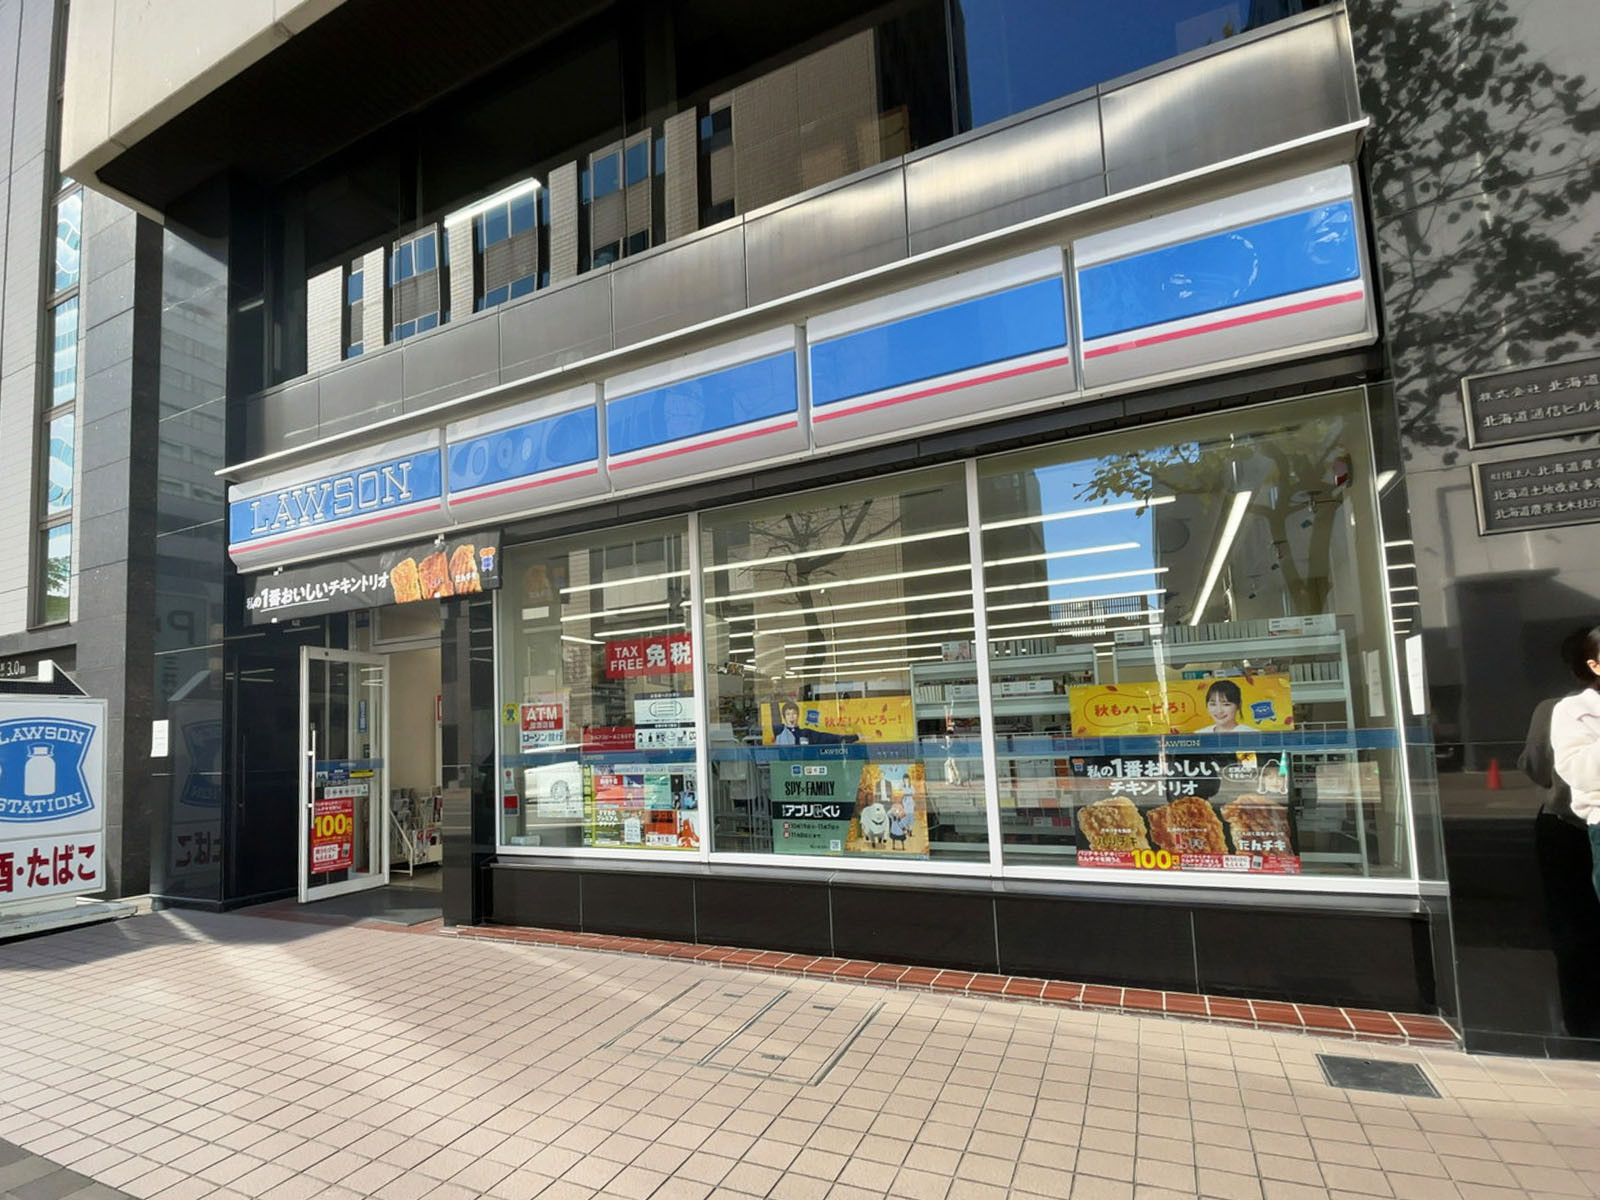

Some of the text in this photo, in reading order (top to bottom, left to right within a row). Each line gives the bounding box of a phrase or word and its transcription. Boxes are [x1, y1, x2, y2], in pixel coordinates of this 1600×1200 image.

[1478, 373, 1600, 402] 株式会社 北海道
[251, 461, 412, 534] LAWSON
[614, 646, 638, 658] TAX
[646, 641, 691, 668] 免税
[610, 658, 643, 671] FREE
[526, 706, 557, 721] ATM
[0, 726, 85, 745] LAWSON
[1087, 758, 1220, 779] 私の1番おいしい
[1109, 780, 1198, 796] チキントリオ
